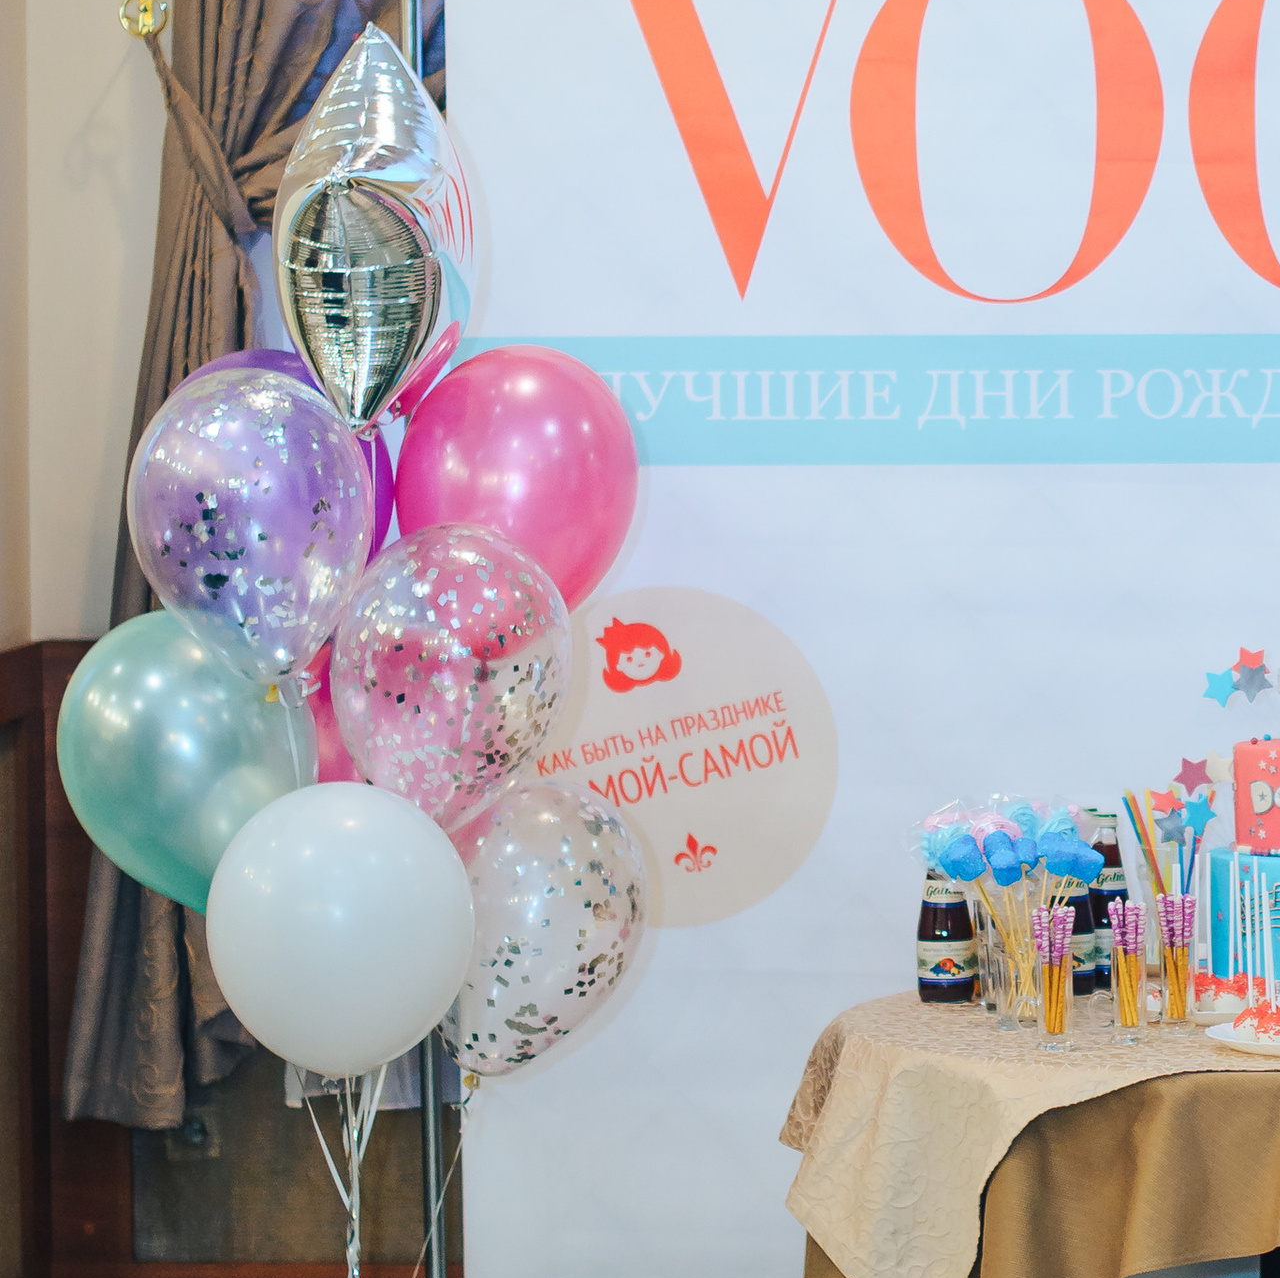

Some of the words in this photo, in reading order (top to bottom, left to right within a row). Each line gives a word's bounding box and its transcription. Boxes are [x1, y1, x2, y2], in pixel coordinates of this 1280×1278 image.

[917, 369, 1074, 431] ДНИ
[536, 748, 578, 777] КАК
[580, 733, 635, 765] БЫТЬ
[638, 723, 668, 749] НА
[670, 690, 787, 741] ПРАЗДНИКЕ
[588, 719, 800, 808] МОЙ-САМОЙ
